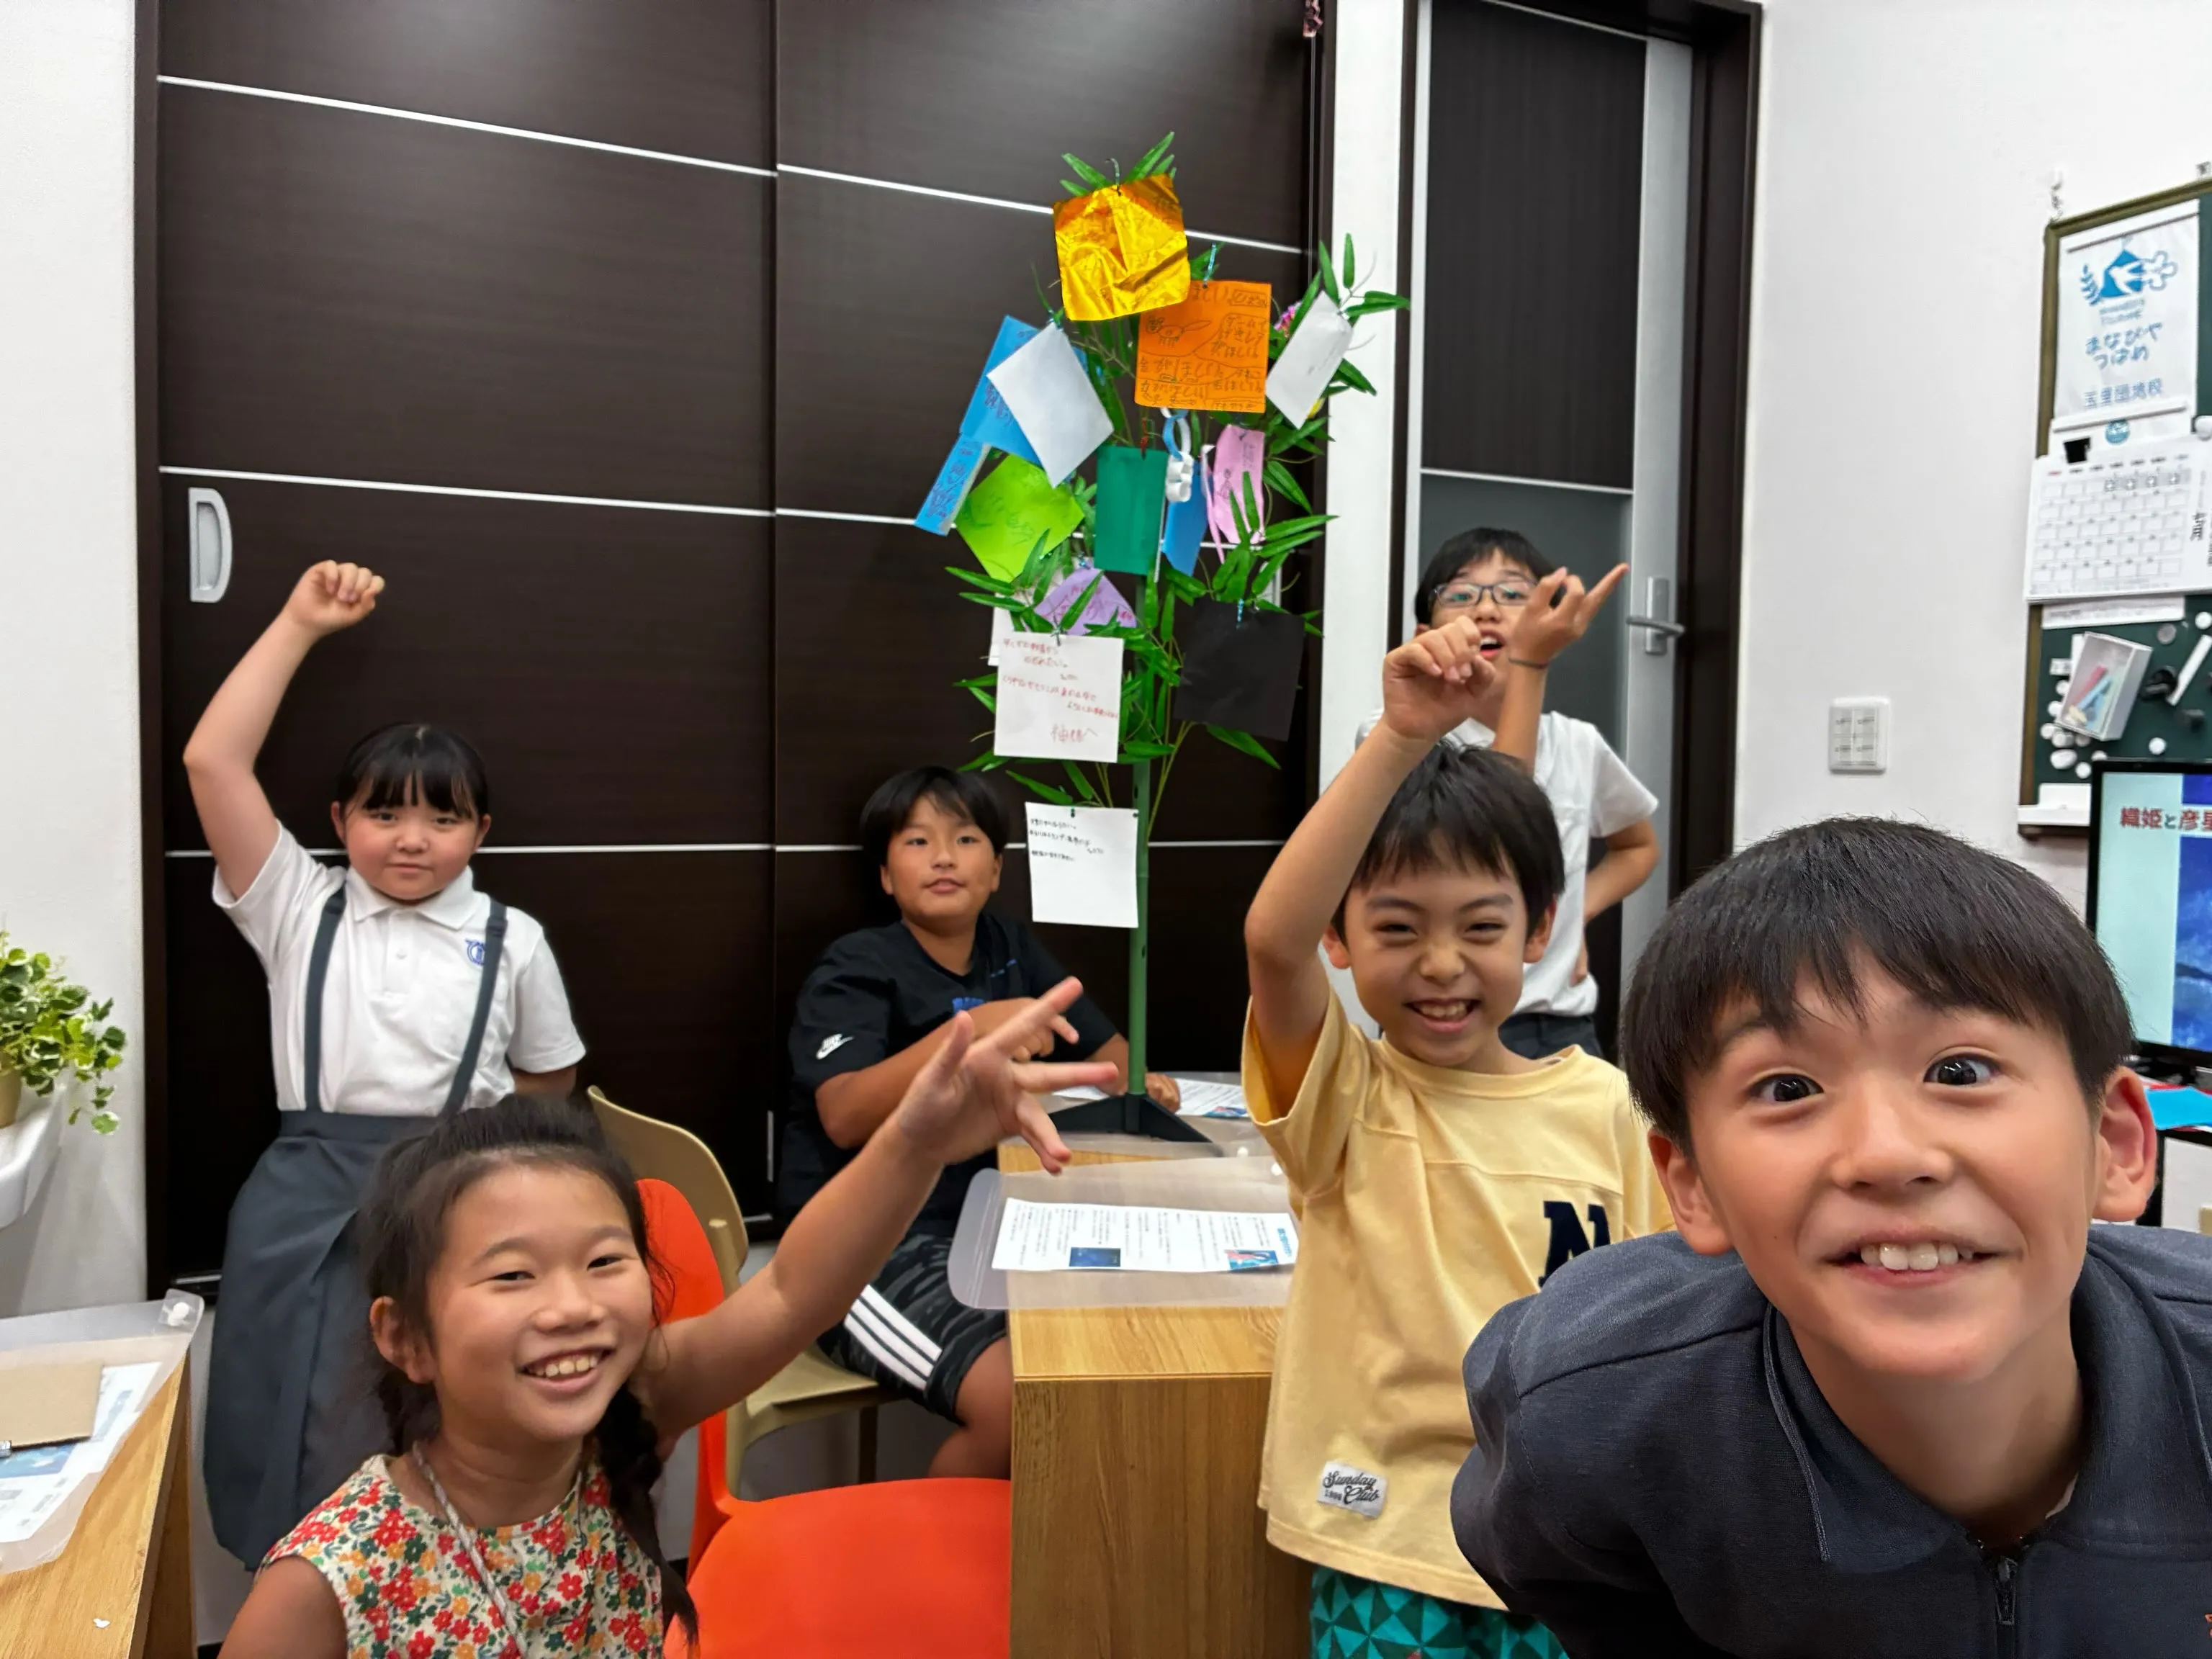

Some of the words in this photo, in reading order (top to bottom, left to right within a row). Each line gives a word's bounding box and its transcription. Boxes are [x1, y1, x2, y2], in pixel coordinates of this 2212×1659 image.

[1538, 1200, 1611, 1288] N
[1323, 1470, 1377, 1491] Sunday
[1344, 1485, 1380, 1505] Club
